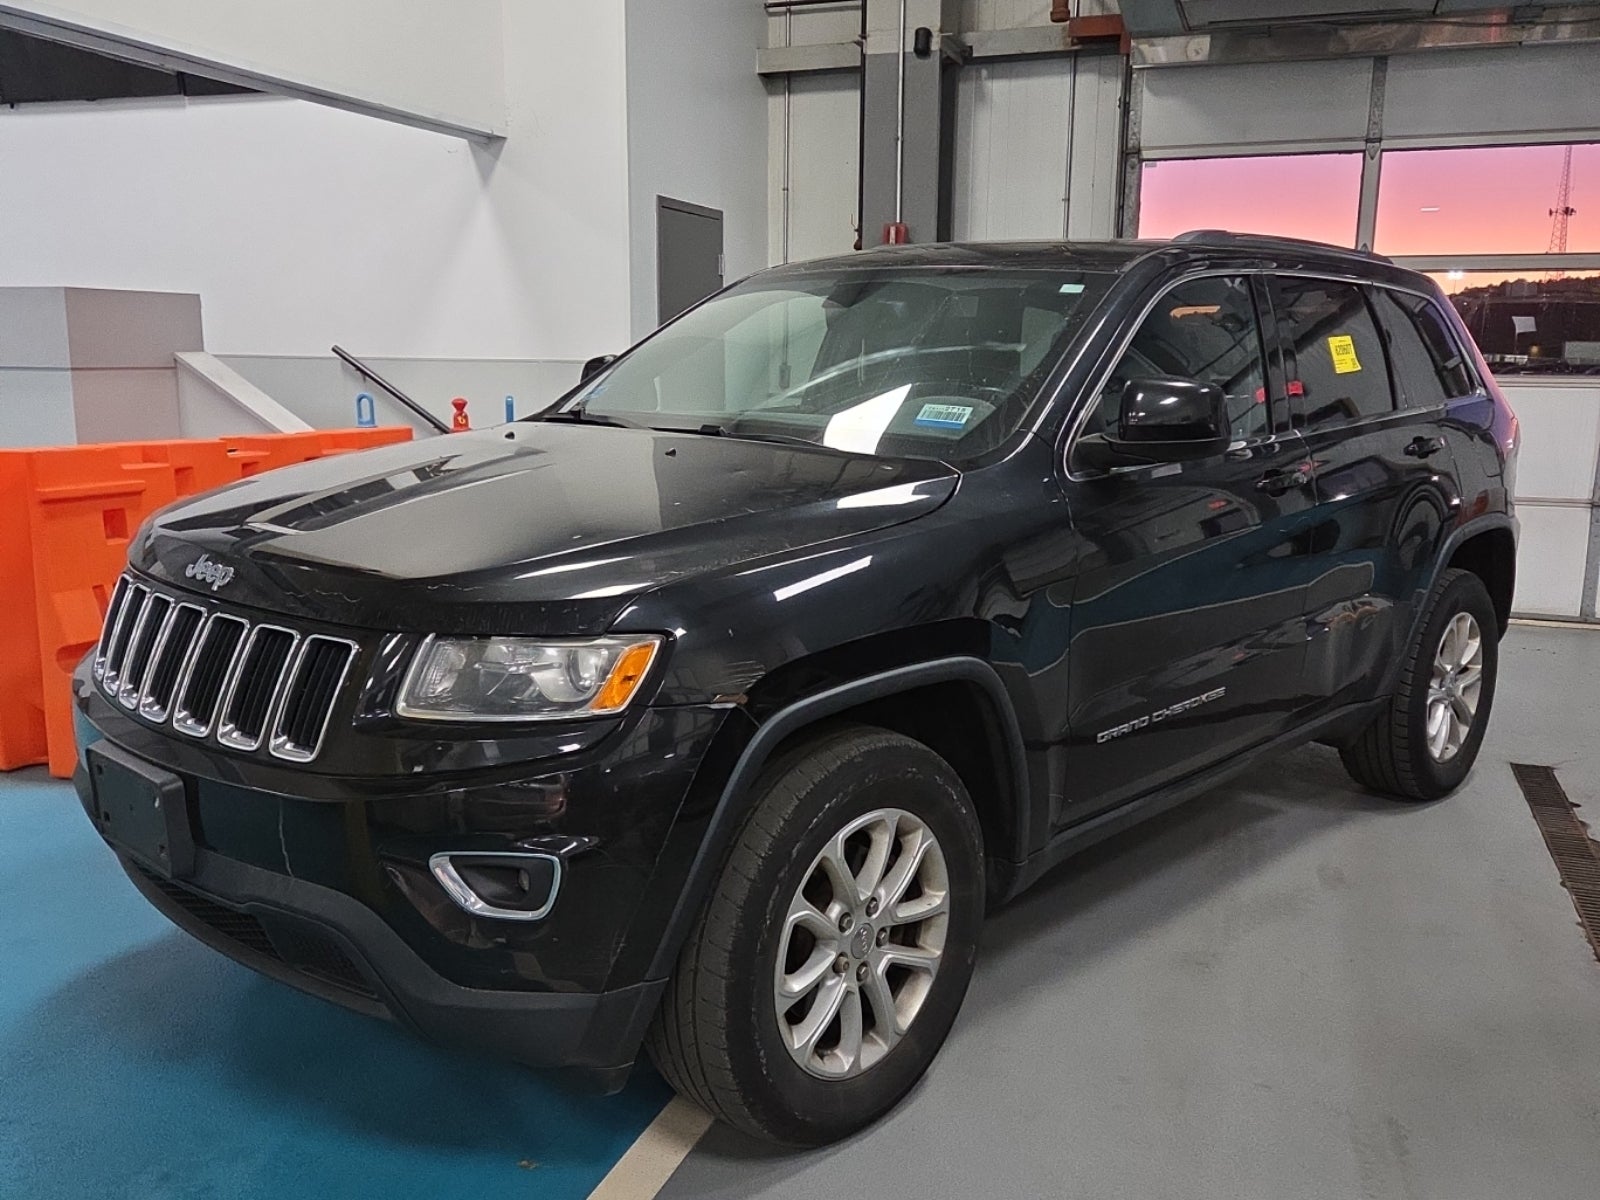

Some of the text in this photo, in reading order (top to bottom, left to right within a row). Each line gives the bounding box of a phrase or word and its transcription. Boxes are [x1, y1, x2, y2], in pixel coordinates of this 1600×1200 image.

[186, 554, 234, 591] Jeep
[1097, 686, 1226, 743] GRAND CHEROKEE
